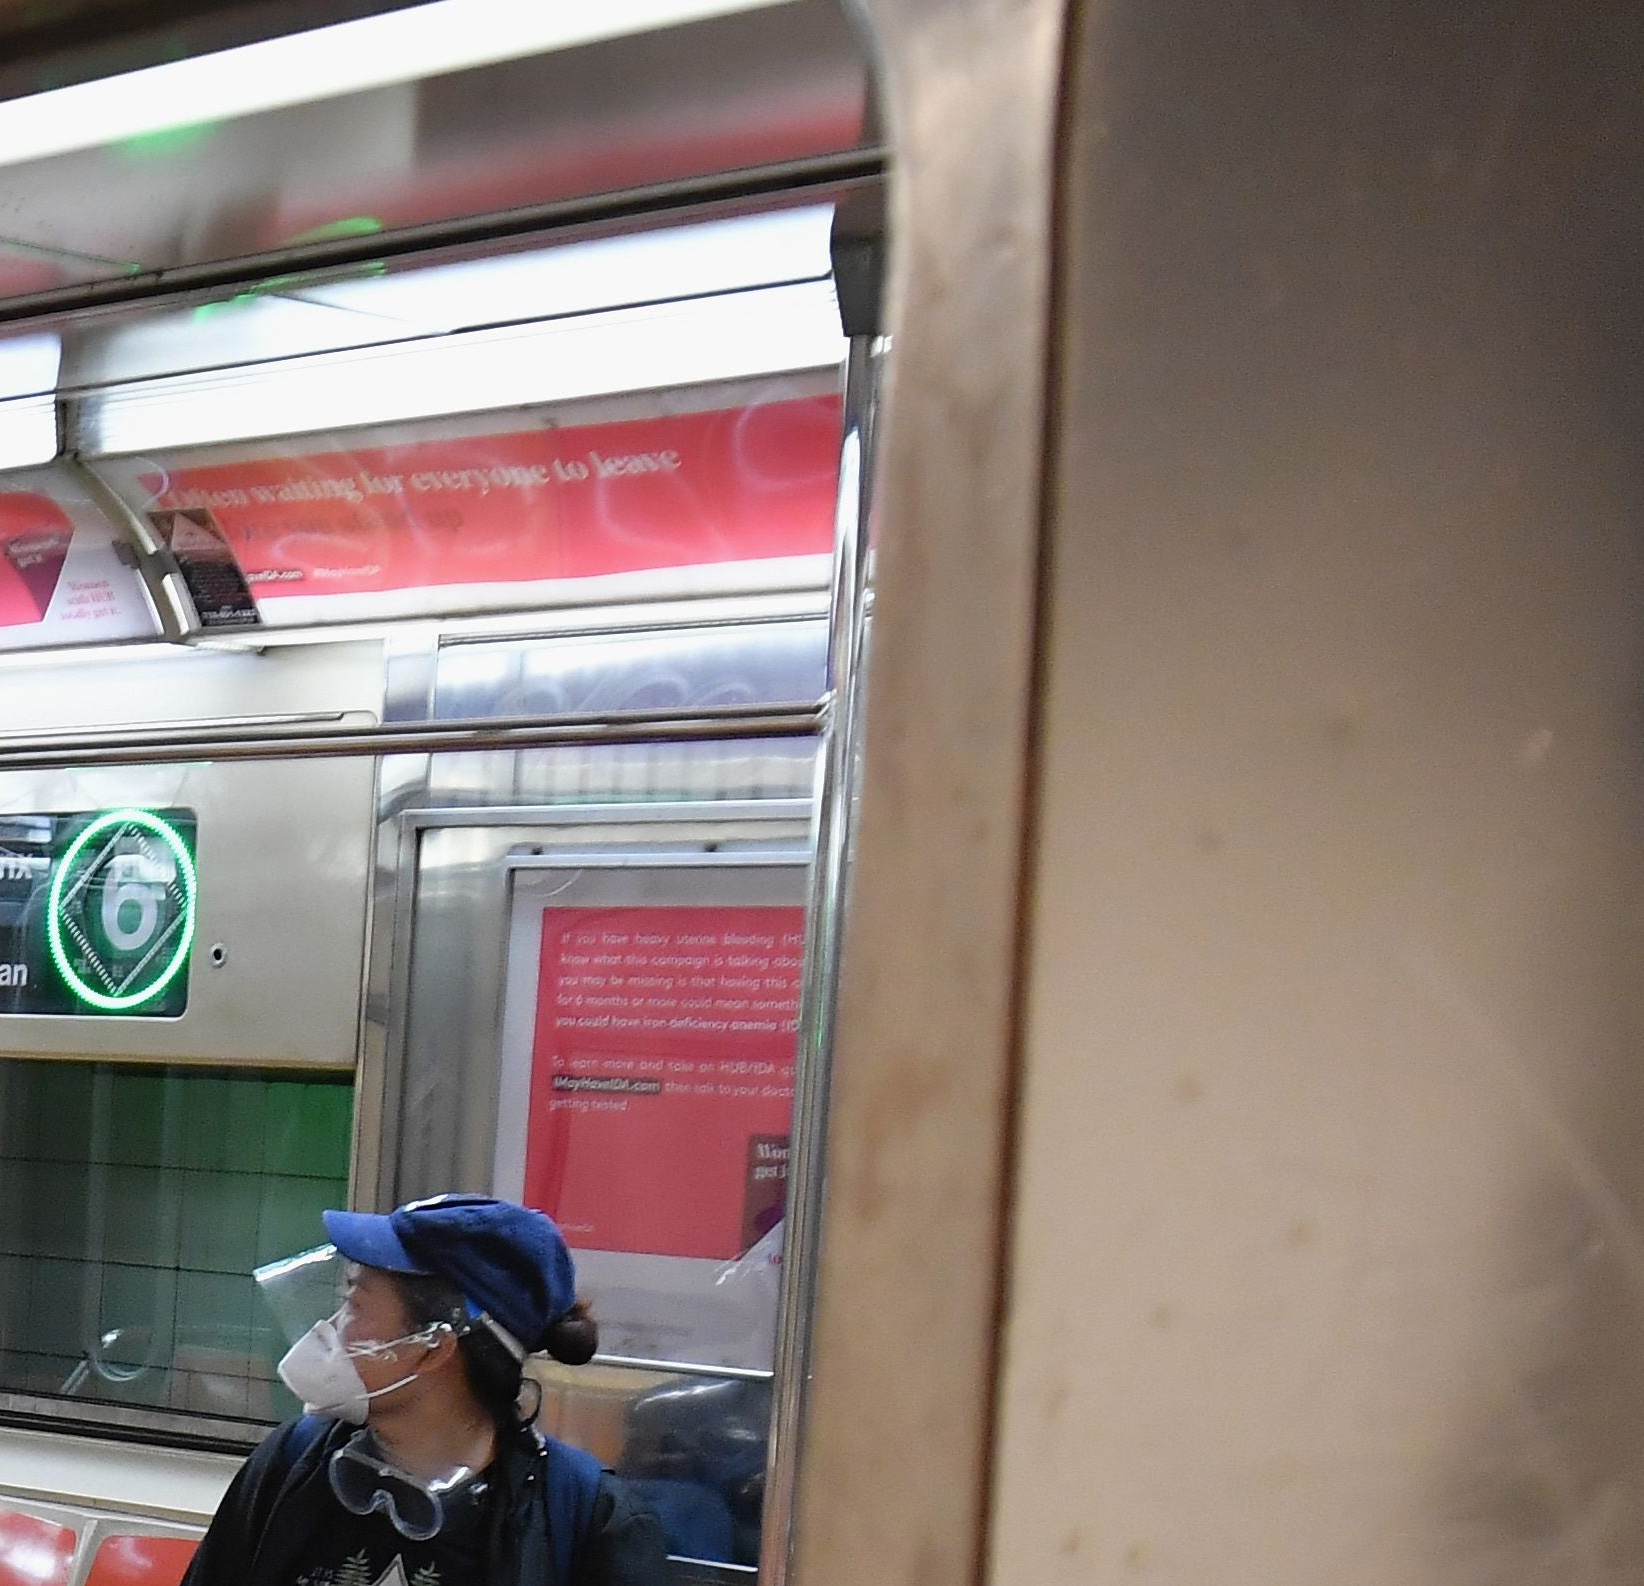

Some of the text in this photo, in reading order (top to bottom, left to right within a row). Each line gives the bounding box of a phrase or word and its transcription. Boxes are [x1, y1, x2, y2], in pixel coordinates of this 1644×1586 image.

[251, 477, 364, 502] waiting
[361, 469, 403, 494] for
[411, 464, 550, 496] everyone
[553, 456, 590, 482] to
[588, 449, 682, 478] leave
[102, 854, 159, 951] 6
[577, 935, 597, 947] you
[602, 932, 629, 945] have
[635, 932, 670, 948] heavy
[677, 933, 716, 945] uterine
[723, 932, 775, 950] bleeding
[594, 952, 622, 966] what
[651, 956, 710, 970] campaign
[728, 955, 769, 971] talking
[559, 976, 579, 988] you
[583, 976, 607, 989] may
[611, 975, 624, 987] be
[628, 976, 674, 990] missing
[692, 976, 715, 988] that
[720, 976, 760, 991] having
[764, 976, 787, 989] this
[557, 993, 574, 1006] for
[586, 995, 630, 1007] months
[632, 998, 645, 1008] or
[647, 998, 676, 1008] more
[679, 997, 712, 1009] could
[715, 999, 749, 1009] mean
[752, 999, 798, 1010] someth
[556, 1017, 576, 1030] you
[577, 1015, 609, 1028] could
[611, 1015, 641, 1028] have
[643, 1016, 667, 1028] iron
[669, 1017, 729, 1033] deficiency
[730, 1019, 777, 1032] anemia
[602, 1060, 635, 1071] more
[640, 1060, 664, 1072] and
[719, 1084, 731, 1095] to
[733, 1086, 759, 1097] your
[550, 1100, 589, 1113] getting
